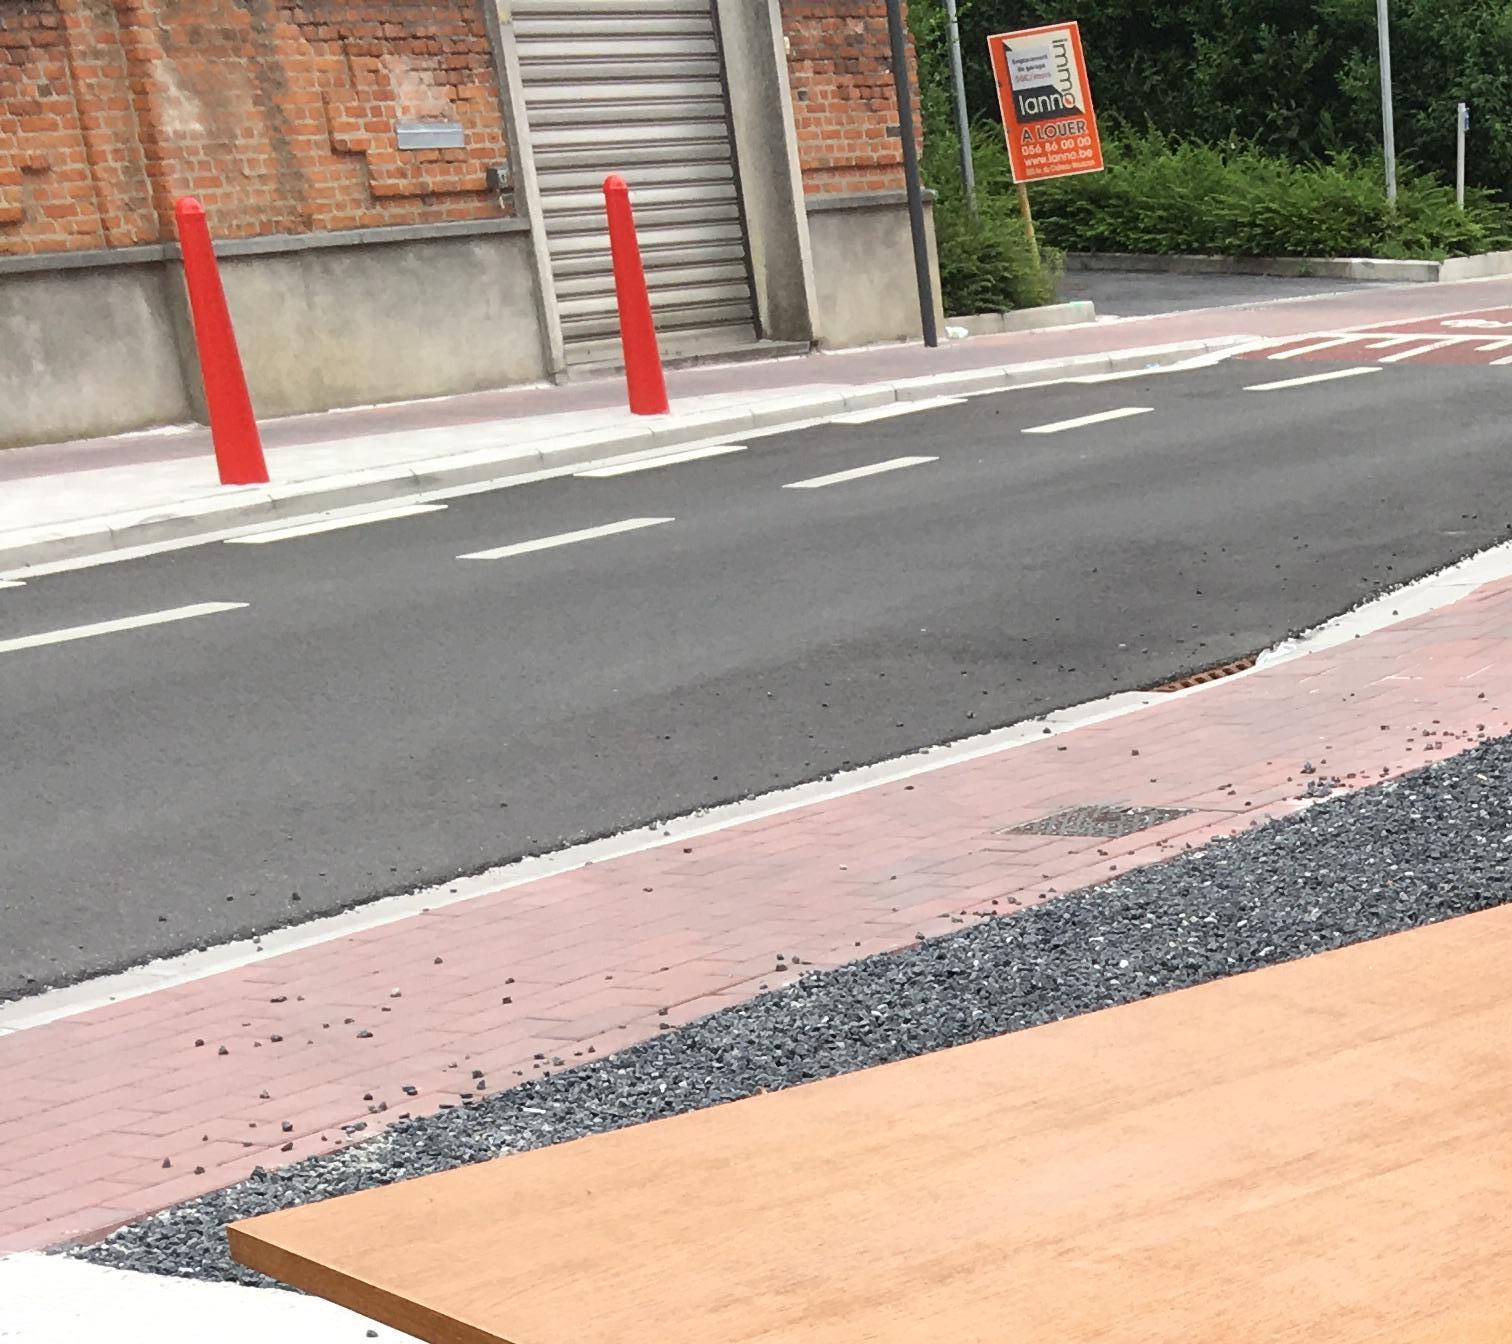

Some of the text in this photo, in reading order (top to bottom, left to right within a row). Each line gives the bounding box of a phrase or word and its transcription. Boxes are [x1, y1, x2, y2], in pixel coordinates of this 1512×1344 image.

[1052, 38, 1076, 108] immo
[1022, 120, 1087, 143] A LOUER
[1022, 136, 1091, 155] 056 86 00 00
[1024, 149, 1092, 166] www.lanno.be
